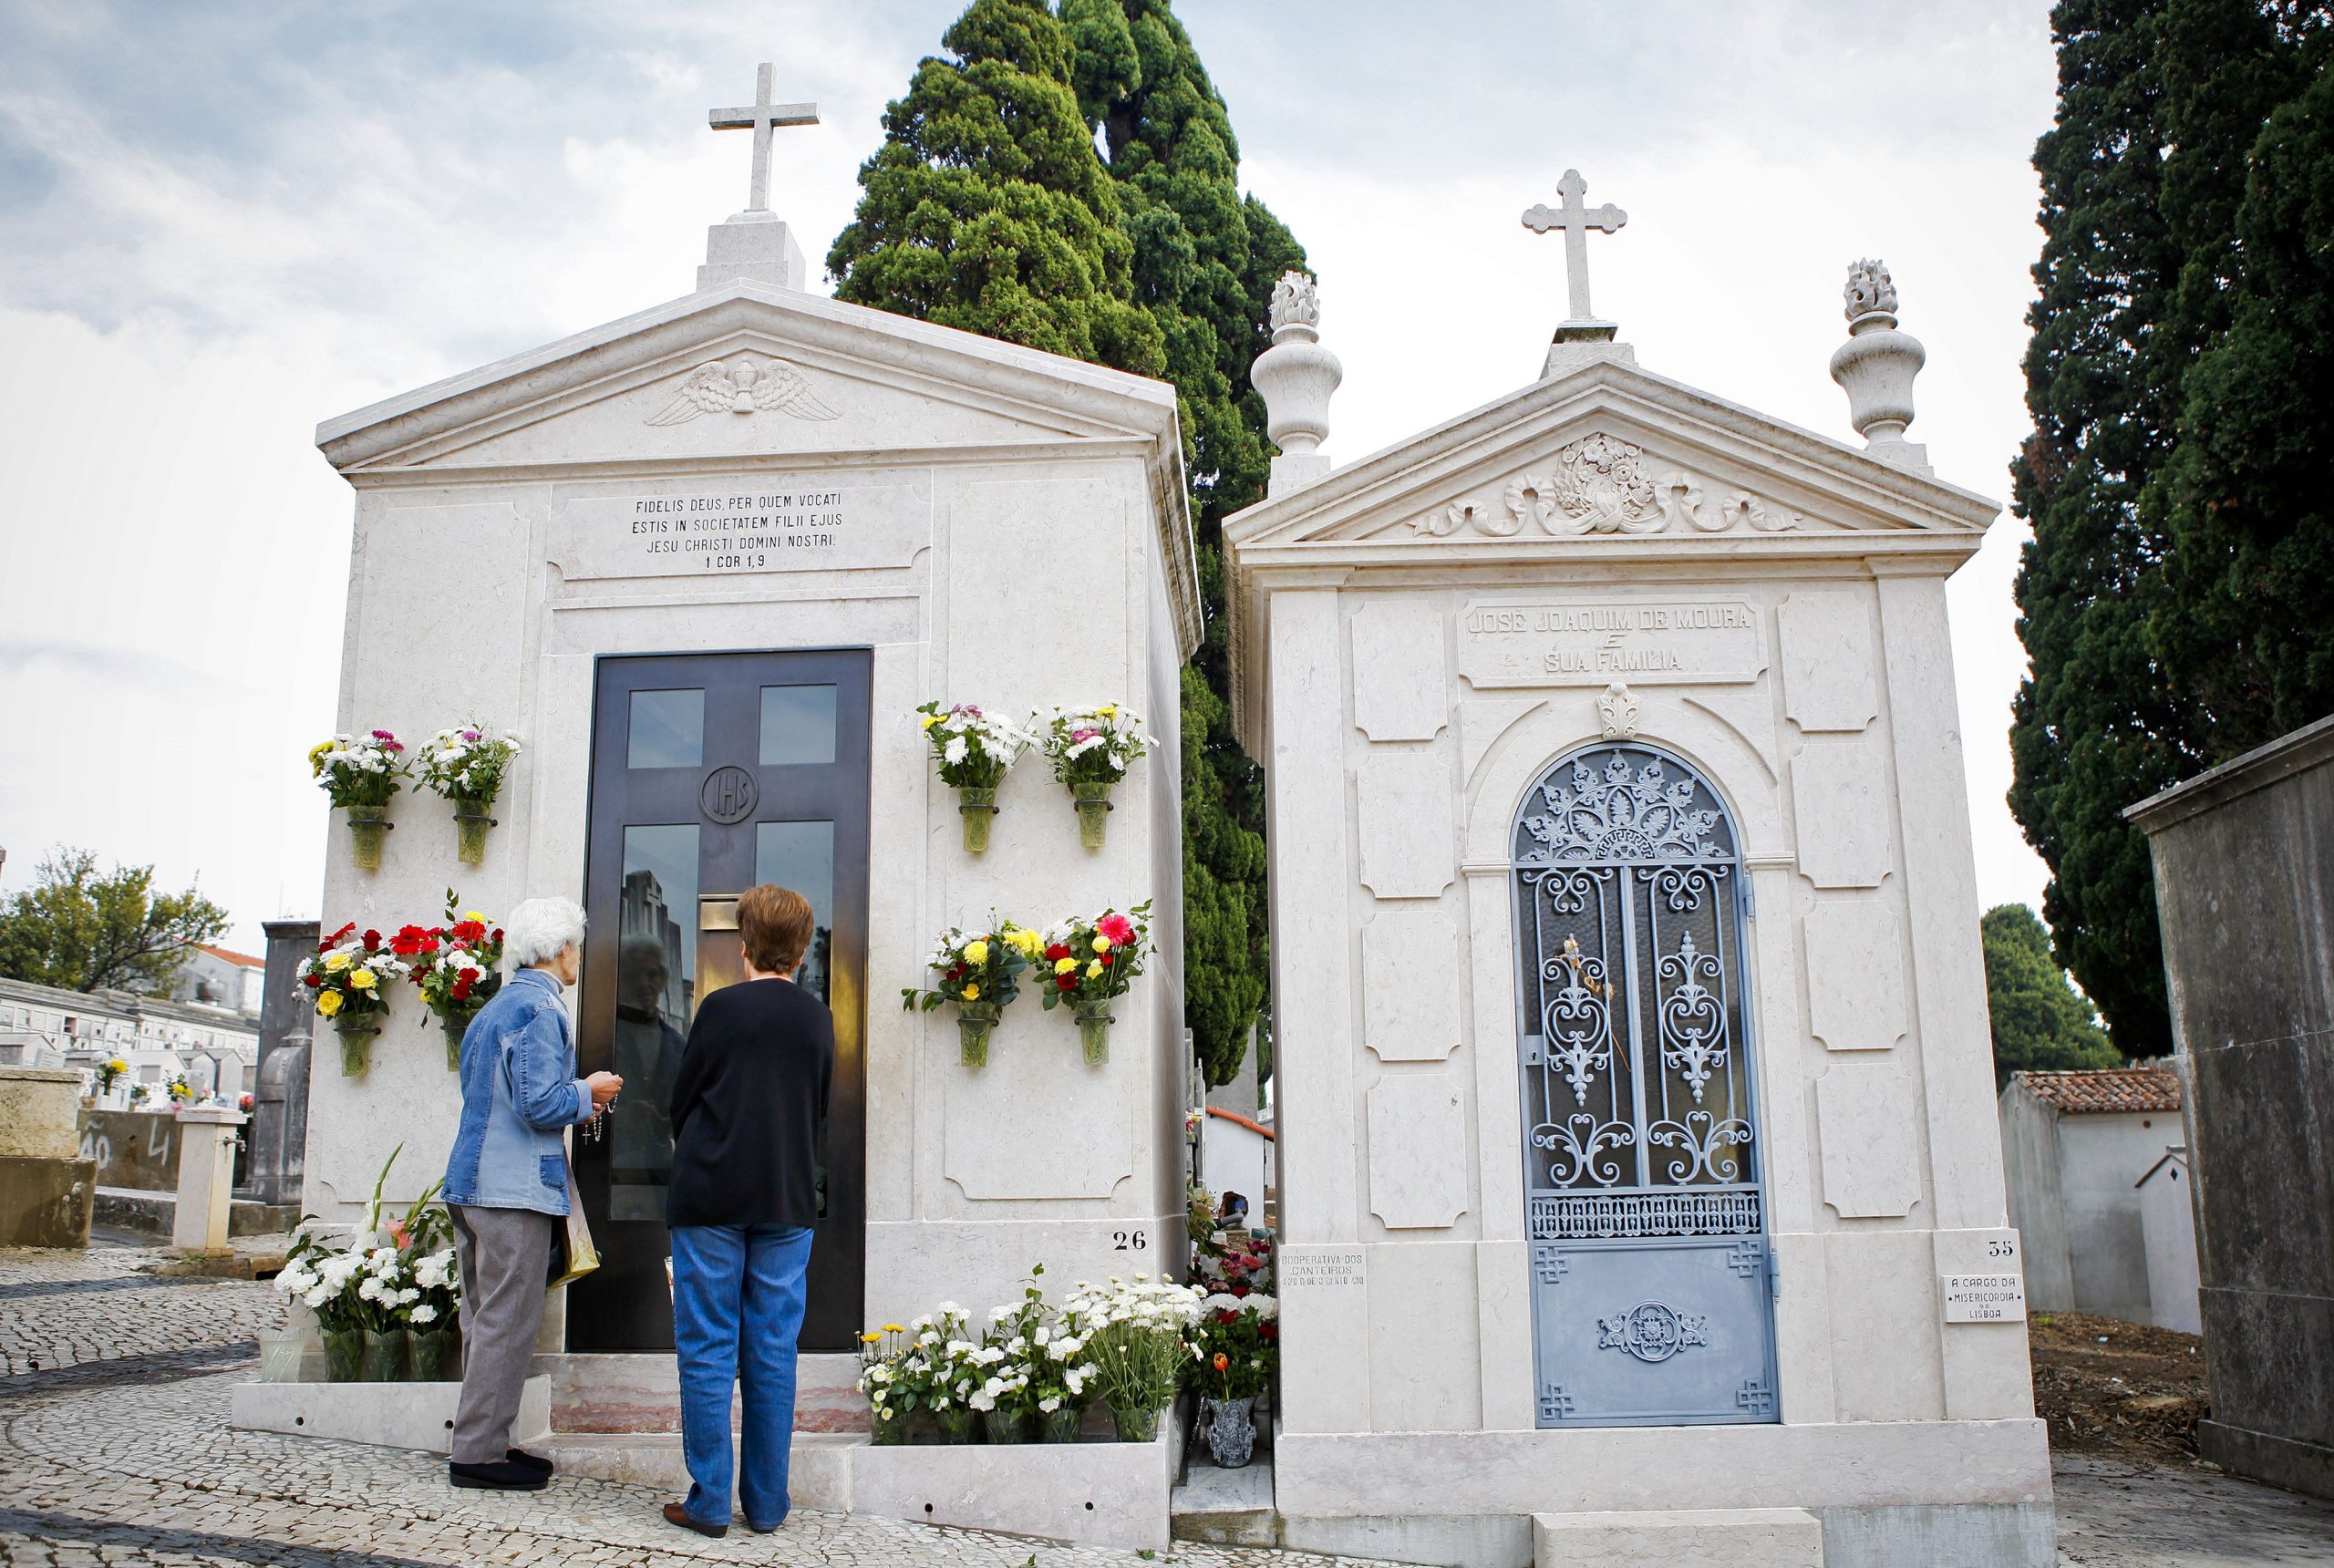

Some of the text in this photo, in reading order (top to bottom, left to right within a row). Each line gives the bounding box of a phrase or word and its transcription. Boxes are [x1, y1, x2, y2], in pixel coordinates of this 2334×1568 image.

[636, 493, 841, 513] FIDELIS DEUS, PER QUEM VOCATI
[632, 513, 842, 534] ESTIS IN SOCIETATEM FILII EJUS
[646, 534, 835, 553] JESU CHRISTI DOMINI NOSTRI.
[706, 557, 710, 568] 1
[717, 556, 740, 568] COR
[1534, 608, 1632, 632] JOAQUIM
[1639, 610, 1668, 630] DE
[1677, 607, 1750, 629] MOURA
[1603, 633, 1627, 648] E
[1545, 650, 1682, 672] SUA FAMILIA
[1113, 1231, 1146, 1250] 26
[1988, 1240, 2013, 1256] 35
[1281, 1254, 1362, 1264] COOPERATIVA DOS
[1292, 1266, 1352, 1274] CANTEIROS
[1951, 1277, 2016, 1287] A CARGO DA
[1969, 1309, 2001, 1318] LISBOA
